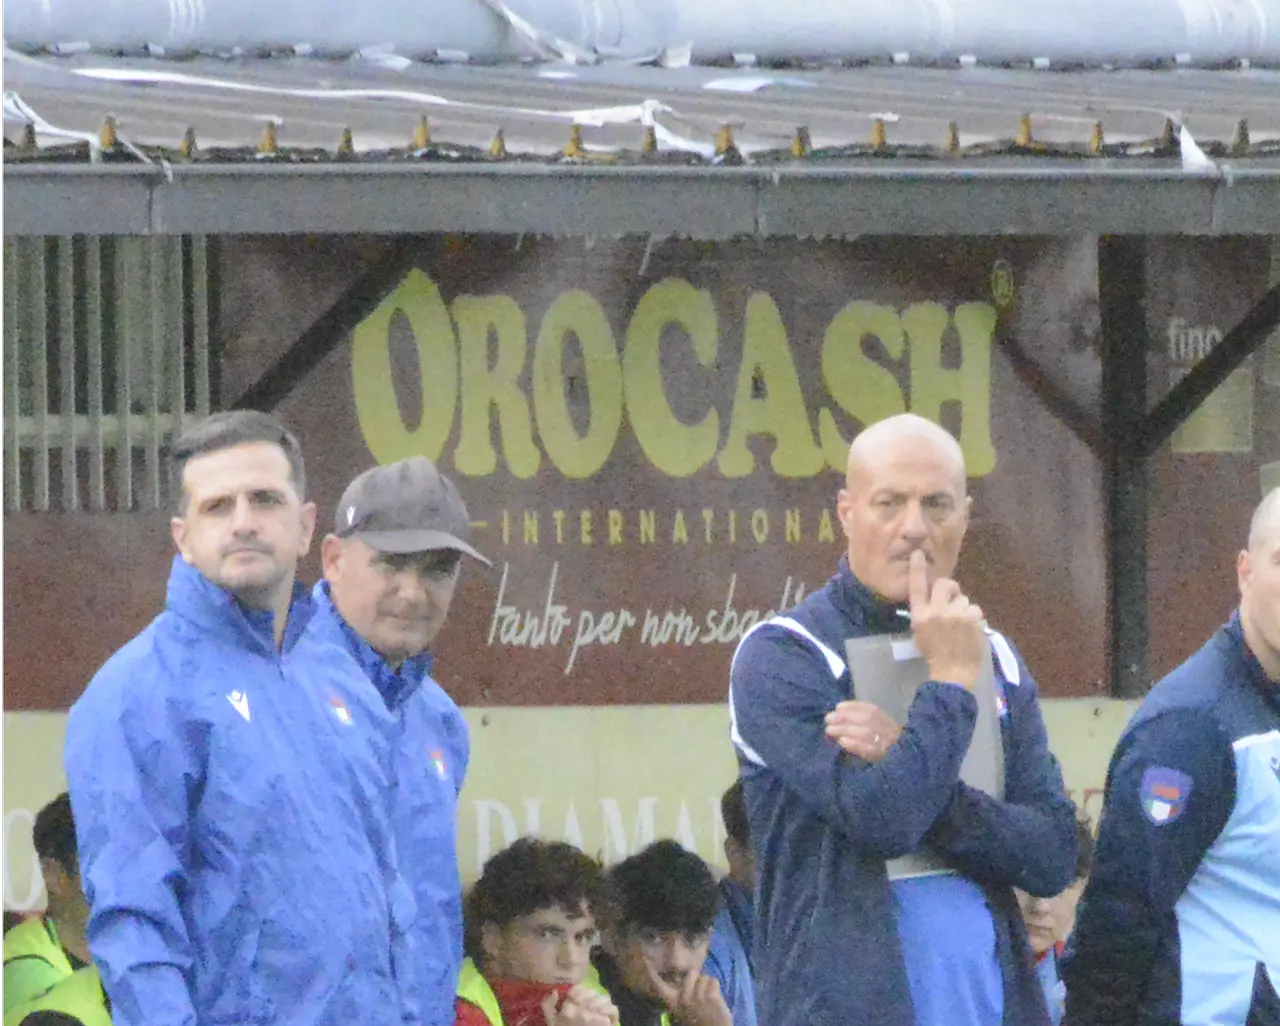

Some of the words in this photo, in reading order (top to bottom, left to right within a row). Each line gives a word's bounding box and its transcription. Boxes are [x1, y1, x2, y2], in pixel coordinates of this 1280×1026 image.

[352, 268, 998, 478] OROCASH
[502, 508, 836, 545] INTERNATIONA
[564, 606, 636, 675] per
[640, 607, 701, 648] non
[472, 797, 732, 882] DIAMA
